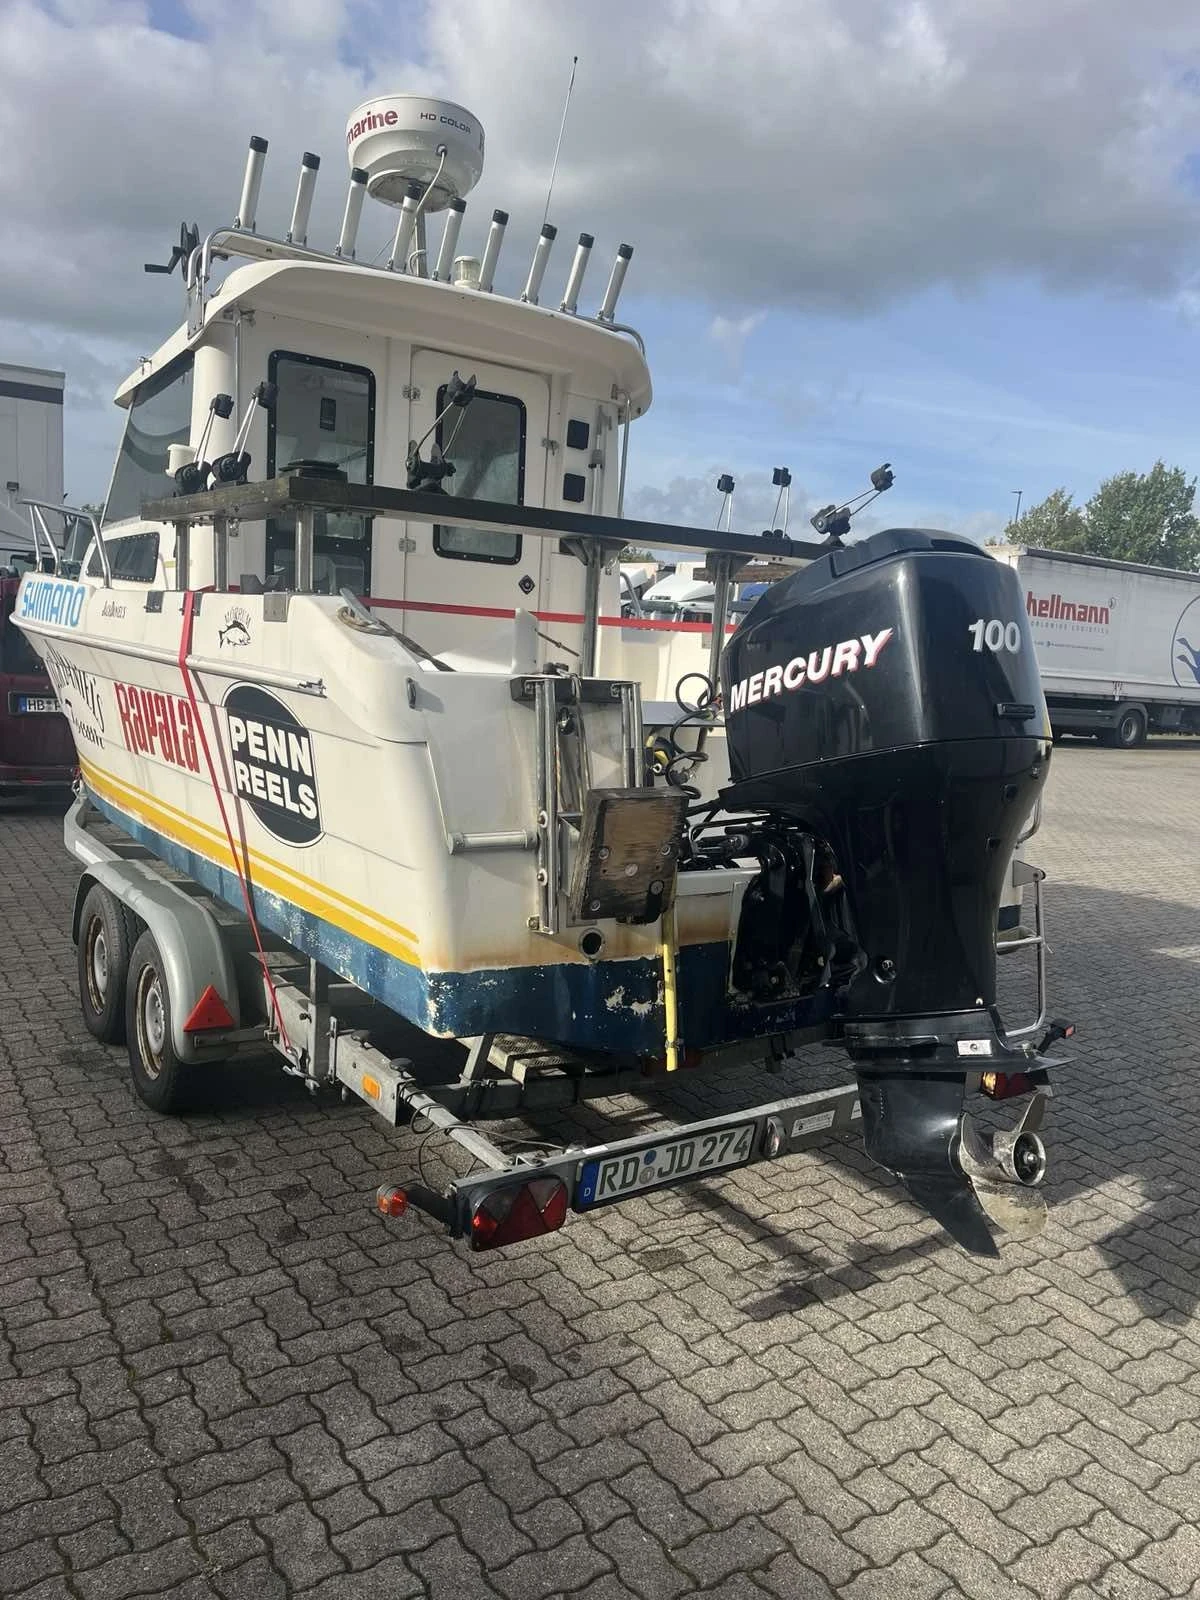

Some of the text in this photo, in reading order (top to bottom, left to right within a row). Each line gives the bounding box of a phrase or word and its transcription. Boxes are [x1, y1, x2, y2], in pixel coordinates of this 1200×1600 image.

[420, 112, 471, 134] HD COLOR
[22, 581, 86, 628] SHIMANO
[1026, 591, 1109, 625] hellmann
[968, 619, 1020, 654] 100
[730, 627, 893, 714] MERCURY
[229, 716, 313, 777] PENN
[234, 759, 318, 820] REELS
[599, 1128, 750, 1195] RD JD 274
[584, 1187, 591, 1197] D
